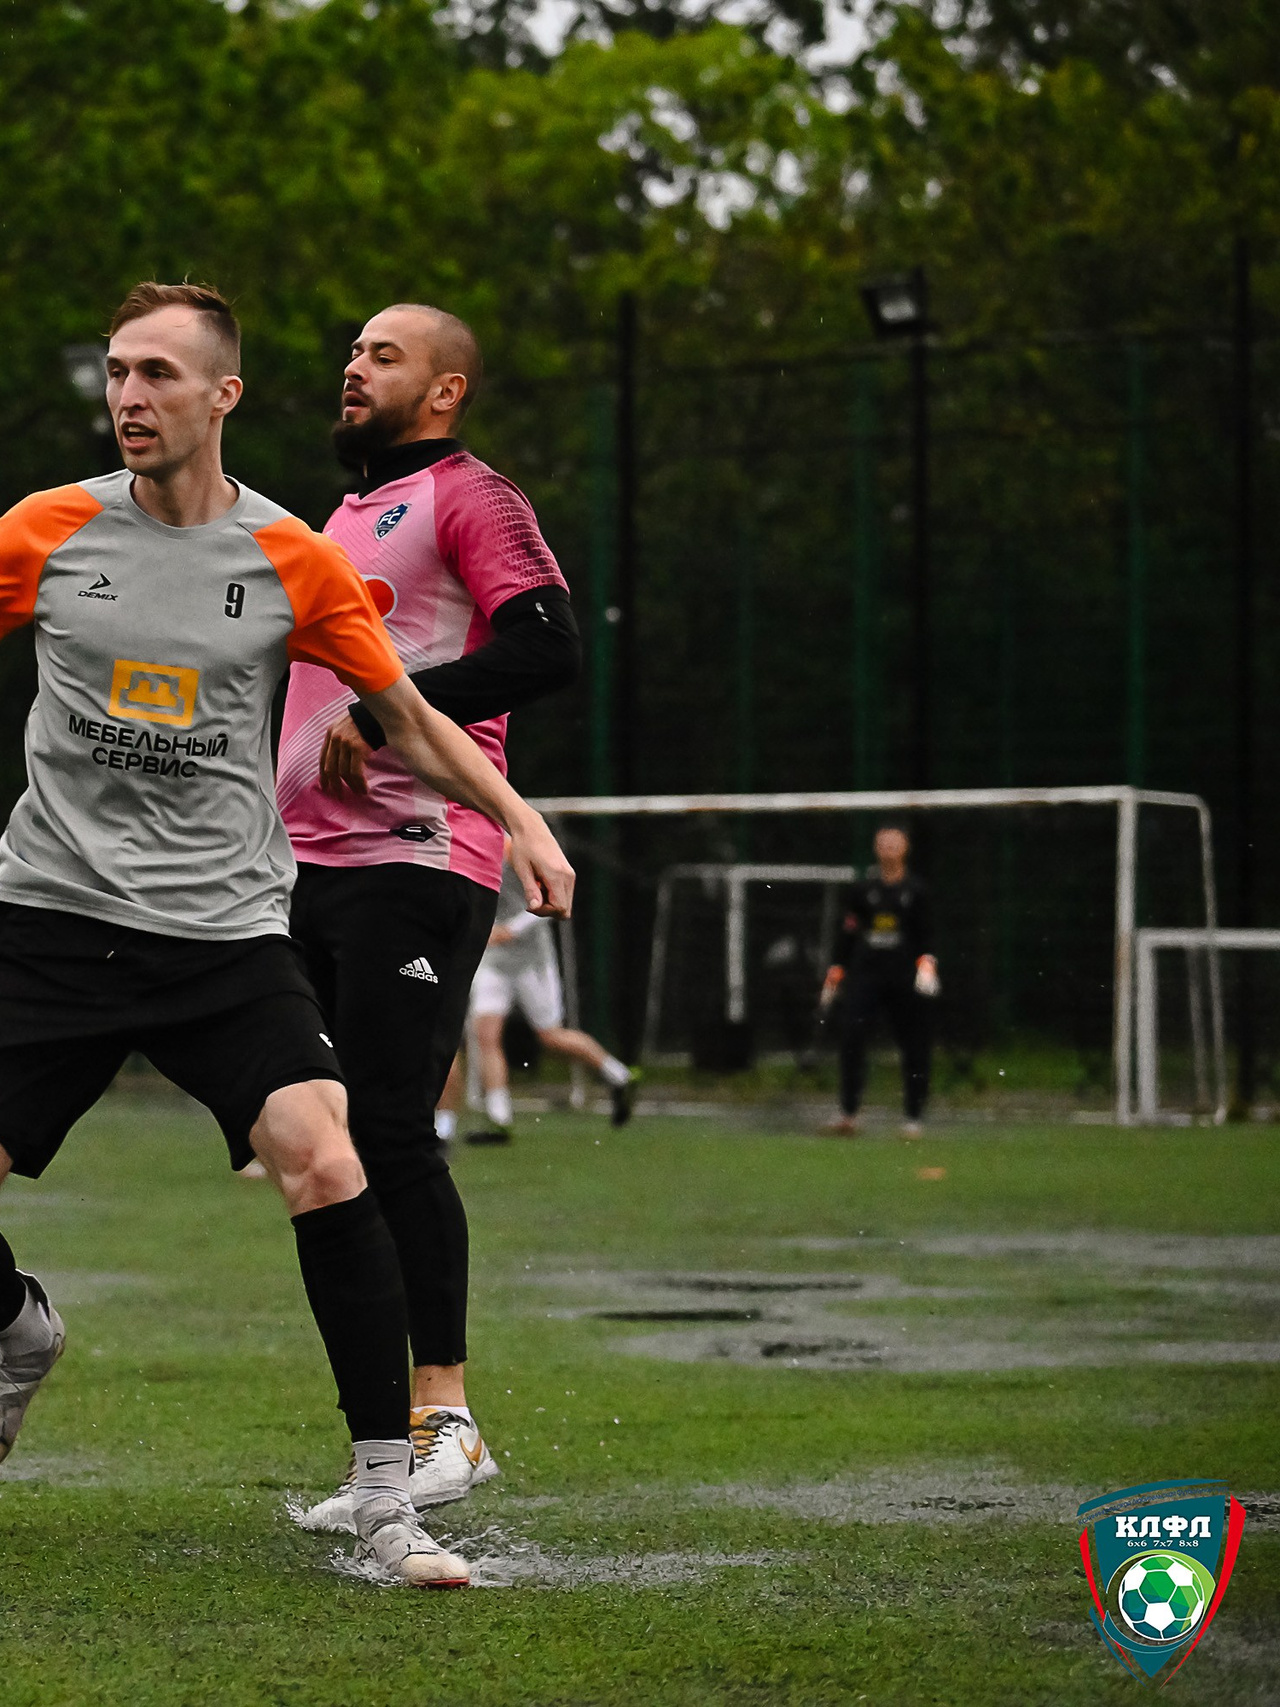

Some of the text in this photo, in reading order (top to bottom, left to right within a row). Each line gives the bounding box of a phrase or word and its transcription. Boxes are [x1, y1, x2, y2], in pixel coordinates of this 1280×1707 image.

[77, 590, 118, 601] DEMIX
[225, 583, 245, 618] 9
[68, 714, 229, 758] МЕБЕЛЬНЫЙ
[92, 747, 198, 778] СЕРВИС
[399, 967, 439, 984] adidas
